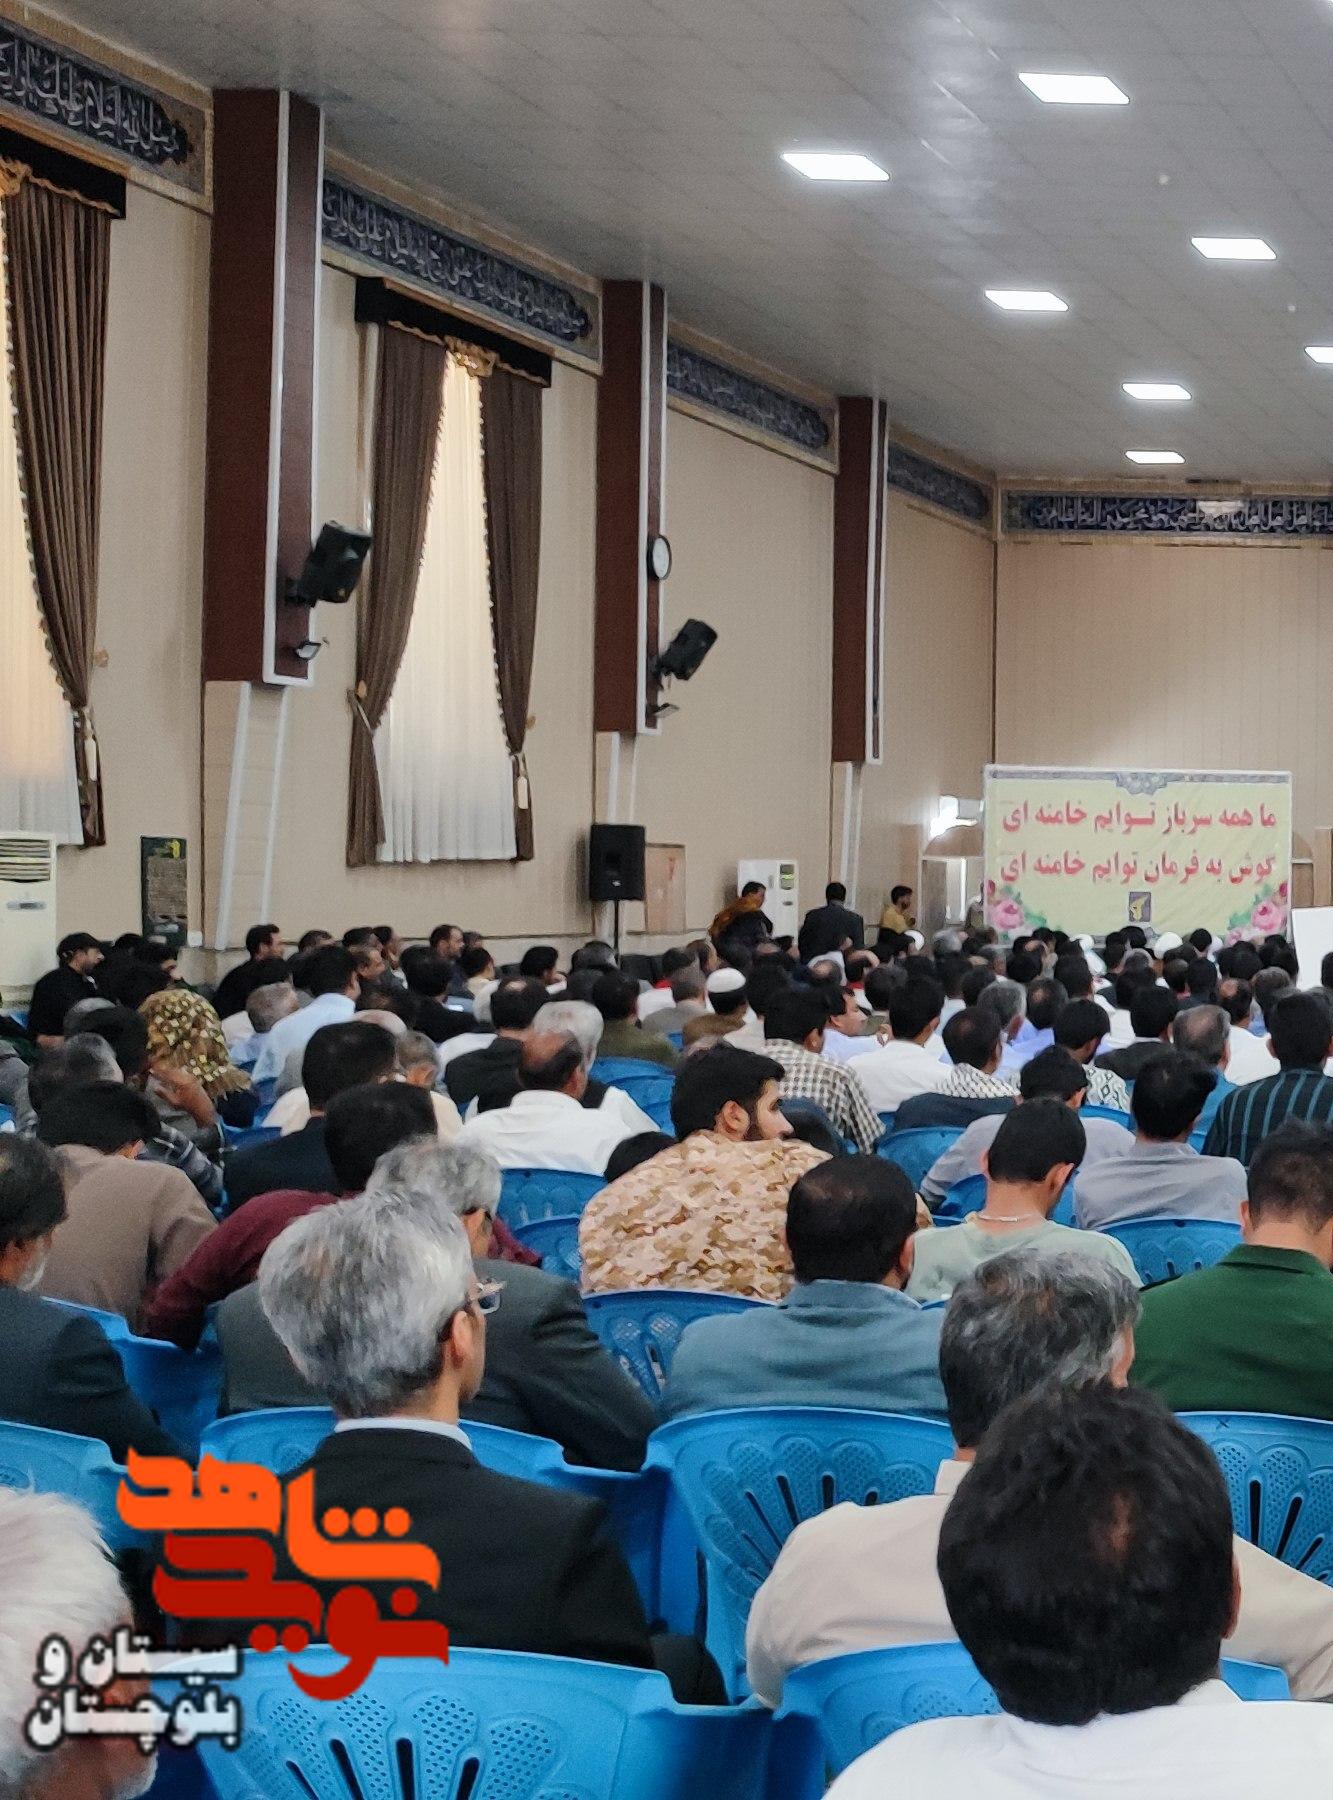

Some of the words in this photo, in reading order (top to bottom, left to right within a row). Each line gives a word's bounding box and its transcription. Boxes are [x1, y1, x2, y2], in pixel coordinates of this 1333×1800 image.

[1218, 808, 1254, 826] همه
[1258, 802, 1277, 827] ما
[1205, 858, 1222, 883] به
[1228, 852, 1276, 885] گوش
